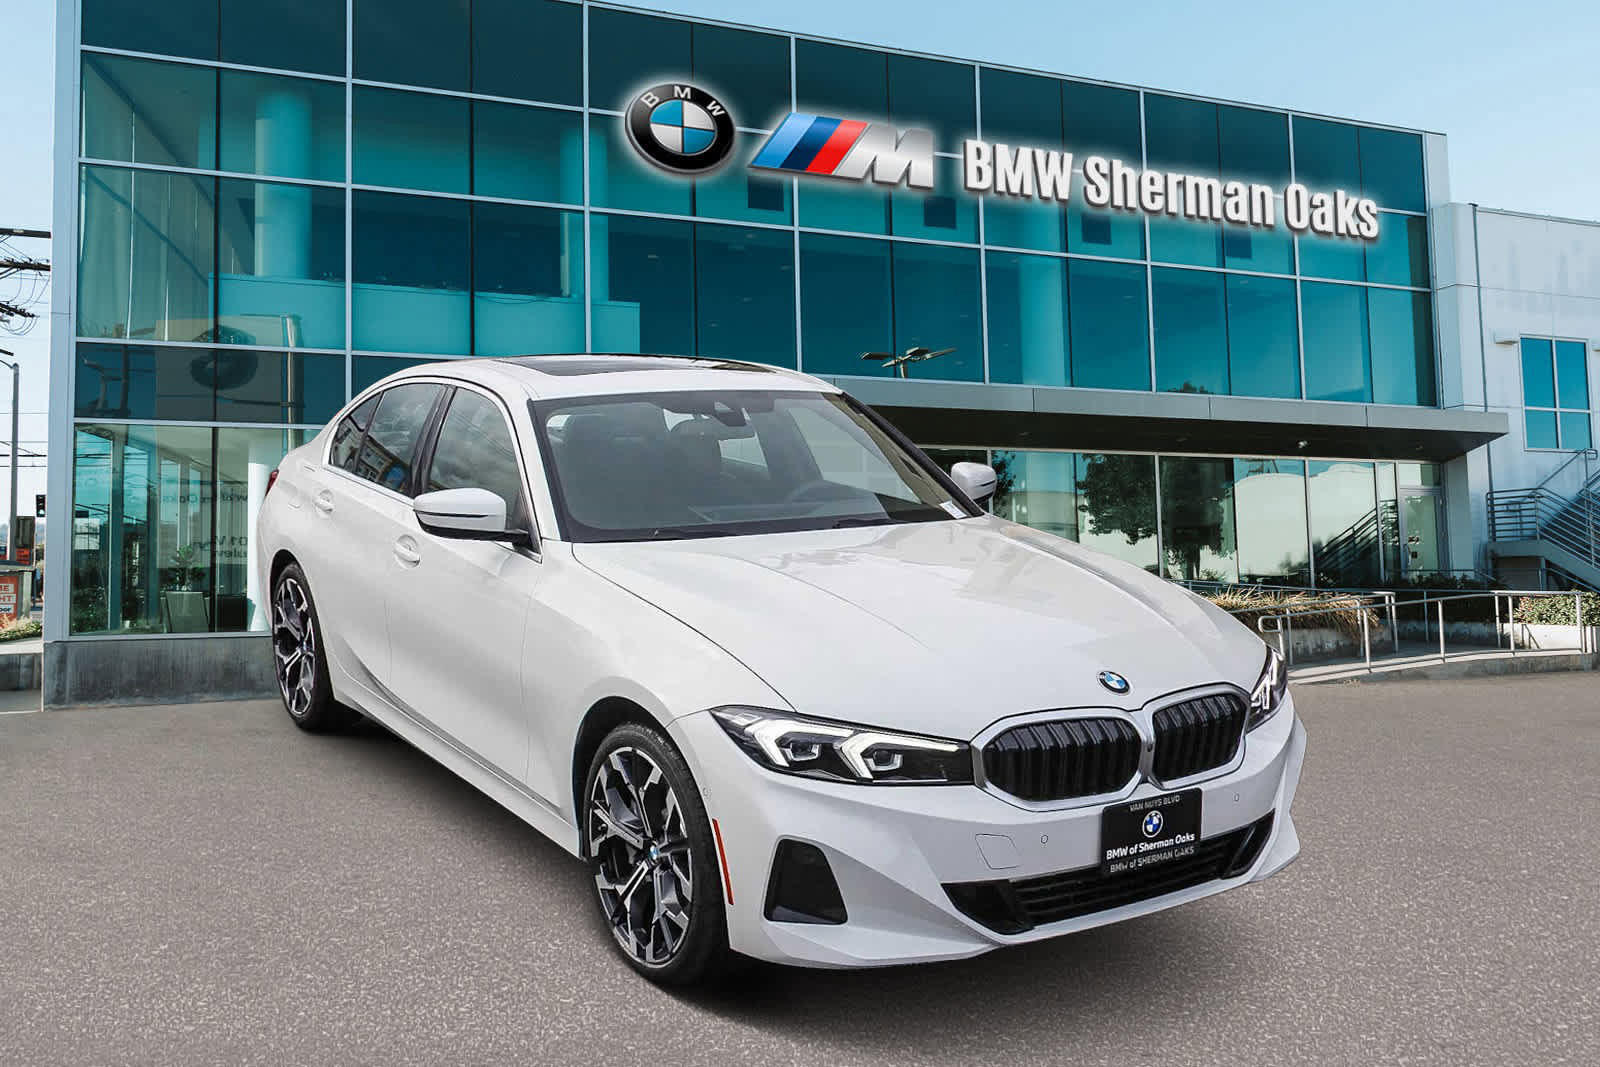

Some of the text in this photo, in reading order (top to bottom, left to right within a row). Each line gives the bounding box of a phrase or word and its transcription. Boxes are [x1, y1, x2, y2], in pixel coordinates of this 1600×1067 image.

[640, 85, 726, 117] BMW
[964, 139, 1380, 241] BMW Sherman Oaks
[1106, 832, 1195, 860] BMW of Sherman Oaks
[1137, 850, 1173, 866] SHERMAN
